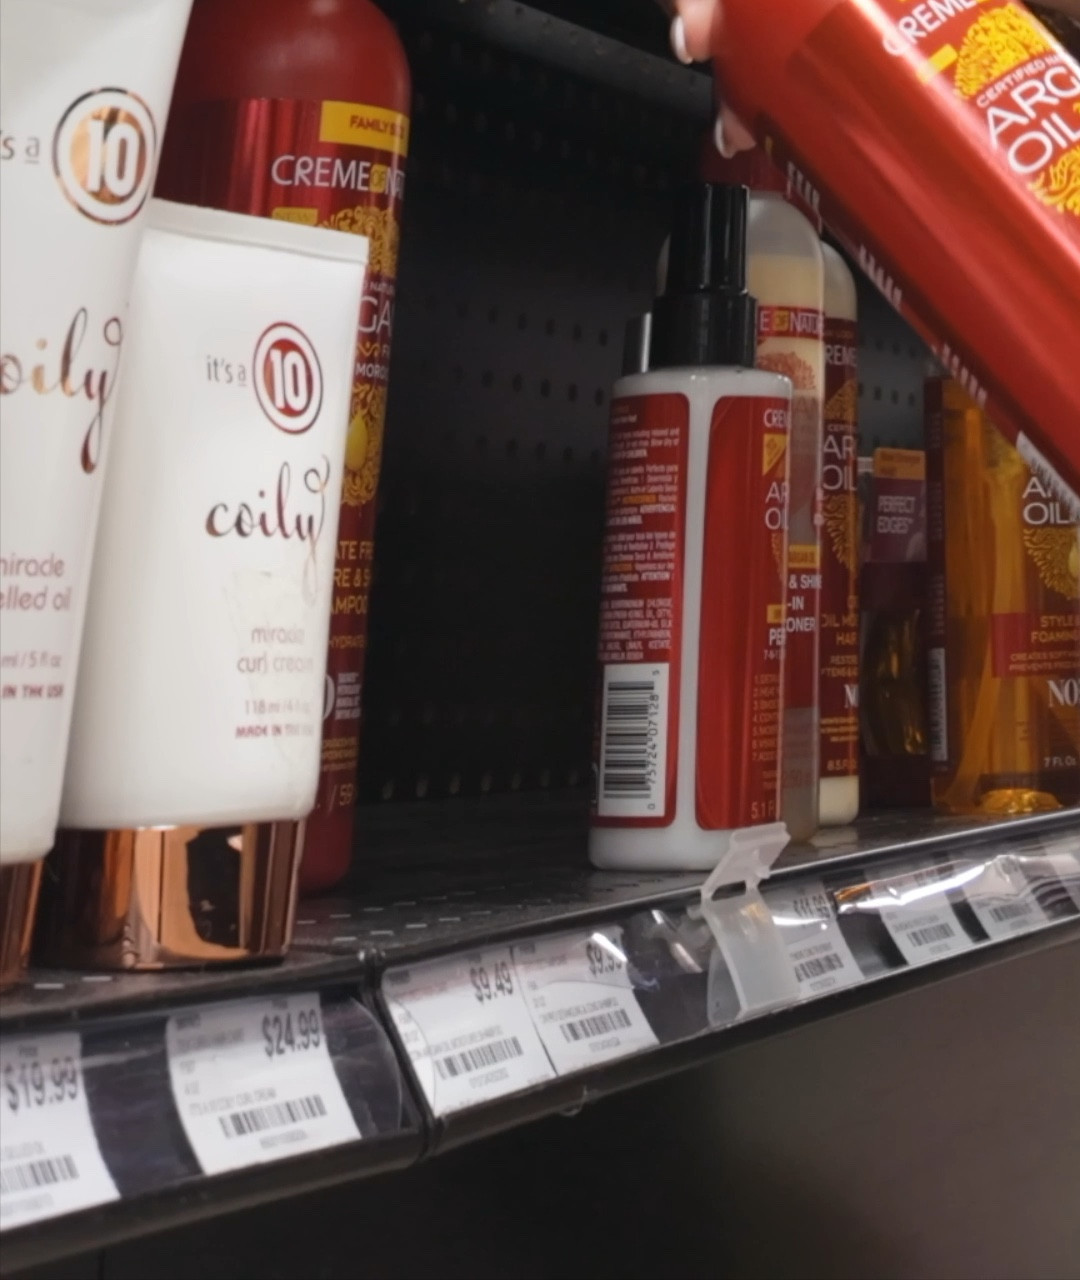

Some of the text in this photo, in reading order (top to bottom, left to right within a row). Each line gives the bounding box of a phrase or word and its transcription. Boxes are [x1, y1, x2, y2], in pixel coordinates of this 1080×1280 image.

[976, 58, 1046, 109] CERTIFIED
[349, 114, 390, 135] FAMILY
[271, 154, 372, 192] CREME
[205, 356, 247, 385] it's a
[269, 347, 305, 412] 10
[205, 454, 331, 608] coily
[1022, 501, 1075, 526] OIL
[1040, 615, 1072, 629] STYLE
[236, 652, 268, 674] curl
[469, 960, 515, 1005] $9.49
[261, 1007, 322, 1060] $24.99
[3, 1055, 79, 1112] $19.99
